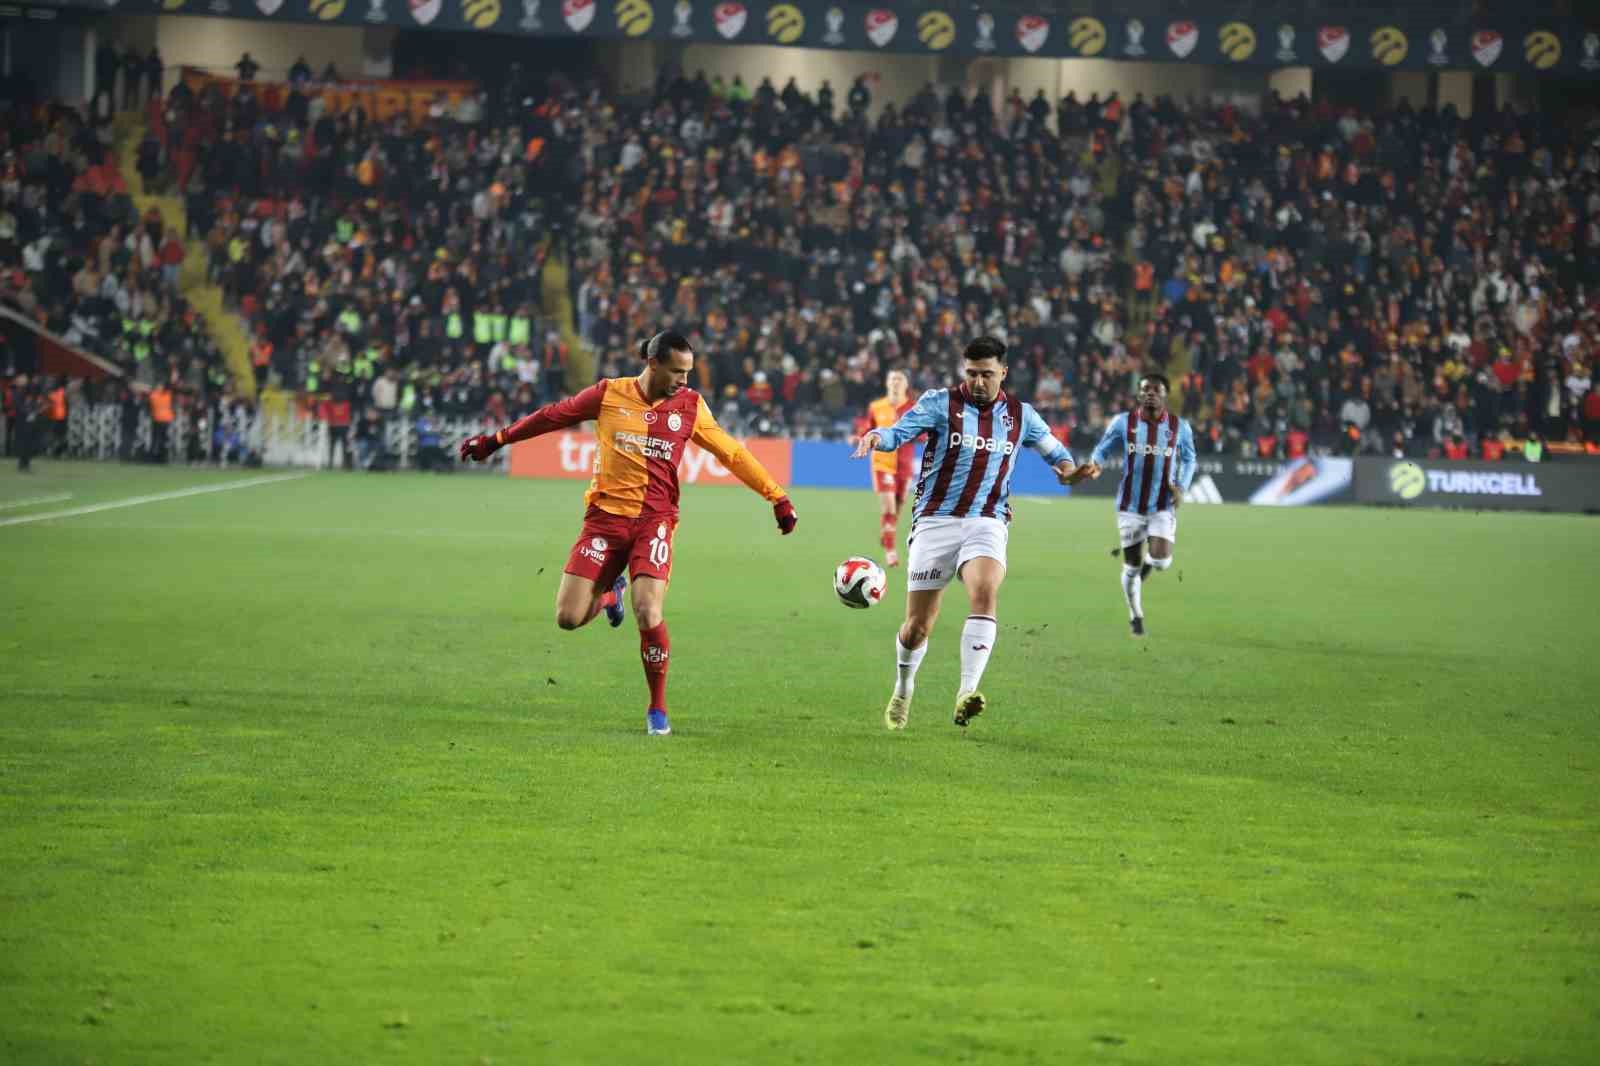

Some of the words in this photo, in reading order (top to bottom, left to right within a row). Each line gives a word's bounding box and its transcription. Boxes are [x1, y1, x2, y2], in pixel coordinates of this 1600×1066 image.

[949, 432, 1015, 455] papara
[1427, 470, 1541, 495] TURKCELL
[649, 537, 669, 564] 10
